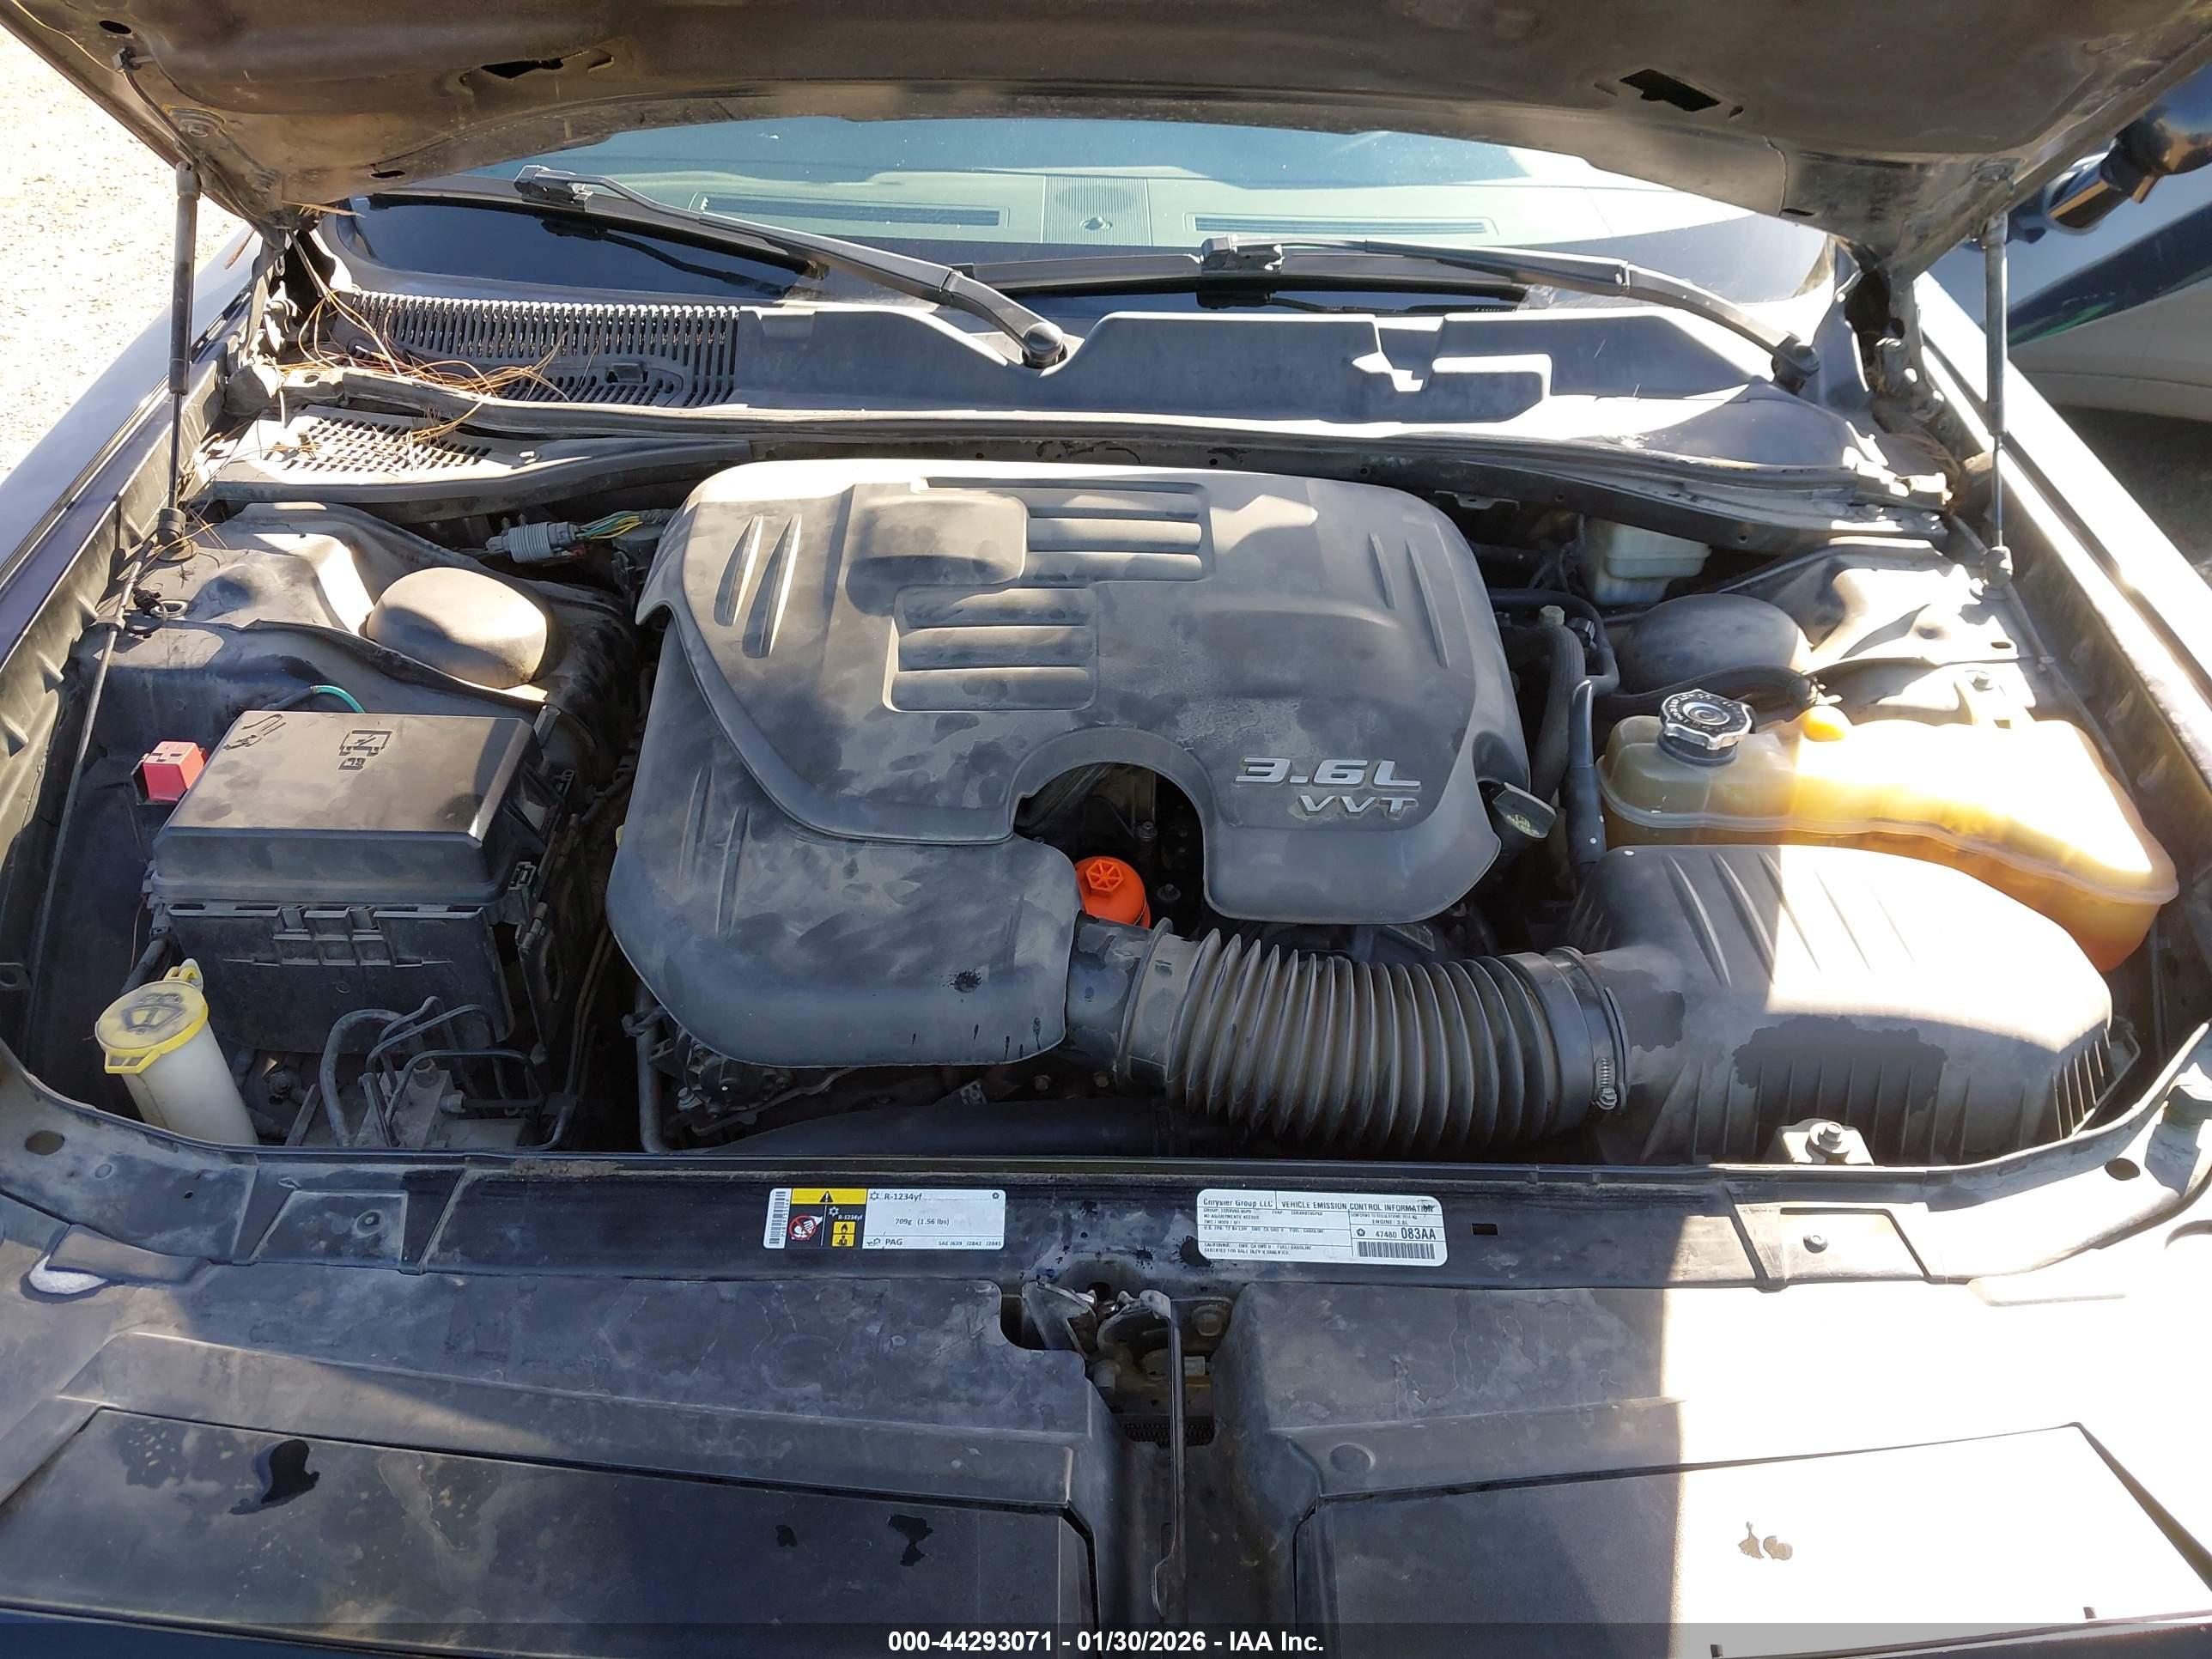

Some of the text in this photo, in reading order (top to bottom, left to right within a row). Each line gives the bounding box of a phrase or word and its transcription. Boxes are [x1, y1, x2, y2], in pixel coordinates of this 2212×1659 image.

[1234, 757, 1422, 787] 3.6L
[1298, 794, 1418, 815] VVT
[884, 1193, 923, 1202] R-1234yf
[1203, 1198, 1233, 1207] Chrysler
[1235, 1200, 1257, 1208] Group
[1281, 1200, 1310, 1209] VEHICLE
[1313, 1201, 1347, 1210] EMISSION
[1384, 1204, 1434, 1212] INFORMATION
[895, 1217, 950, 1226] 709g (1.56 lbs)
[1401, 1227, 1437, 1240] 083AA
